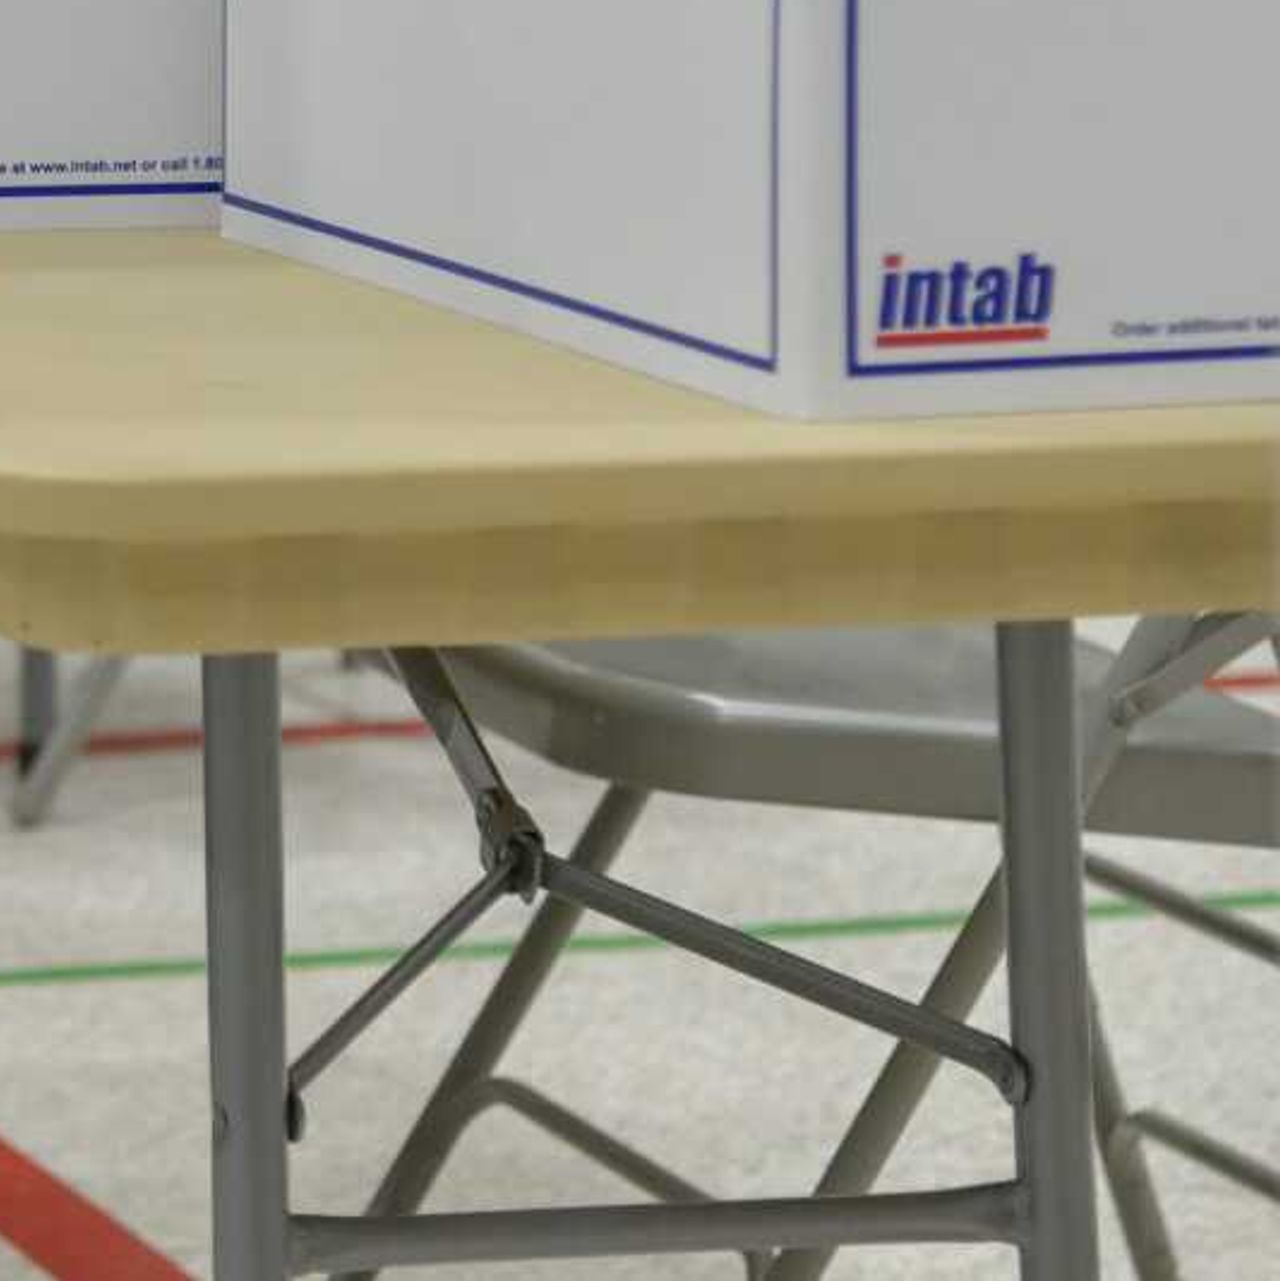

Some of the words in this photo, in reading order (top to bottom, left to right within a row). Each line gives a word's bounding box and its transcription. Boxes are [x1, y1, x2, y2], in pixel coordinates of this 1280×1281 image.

[13, 160, 26, 174] at
[30, 158, 137, 173] www.intab.net
[142, 159, 158, 170] or
[161, 156, 187, 170] call
[878, 252, 1056, 329] intab
